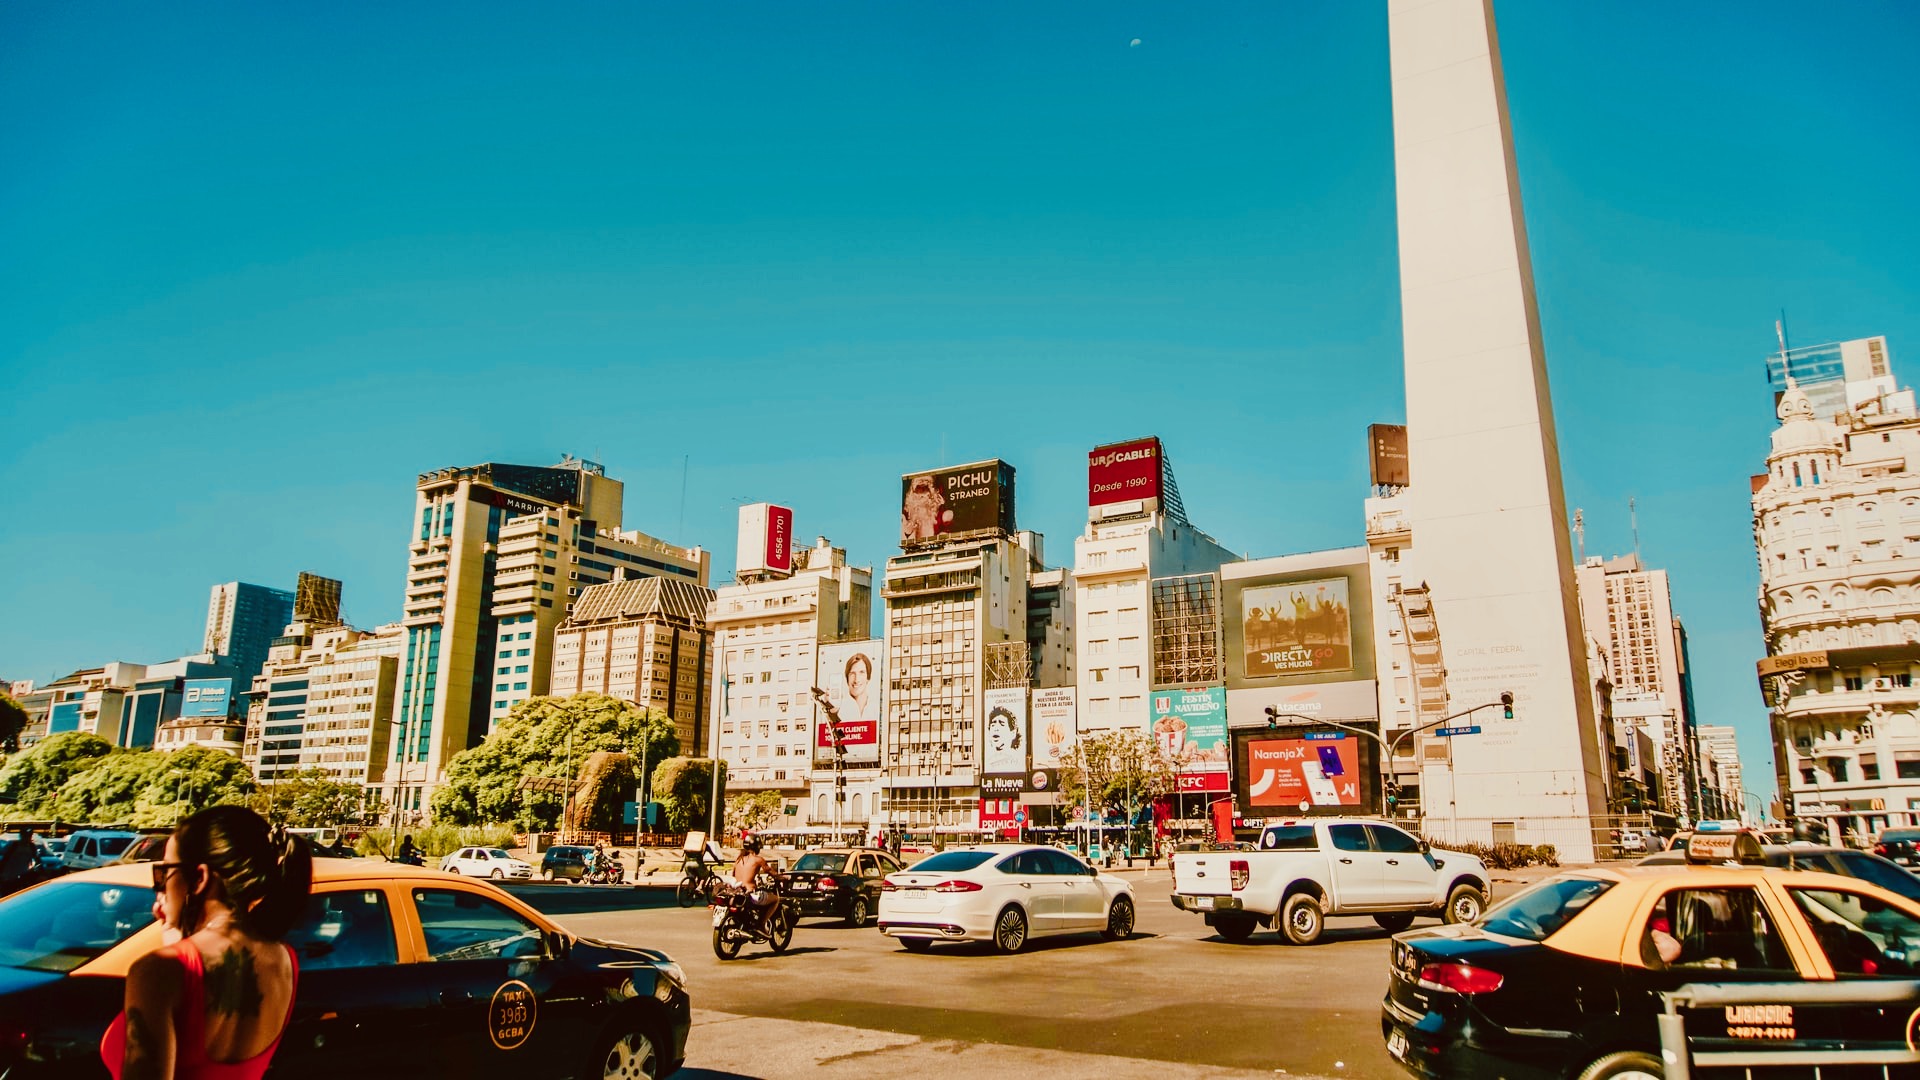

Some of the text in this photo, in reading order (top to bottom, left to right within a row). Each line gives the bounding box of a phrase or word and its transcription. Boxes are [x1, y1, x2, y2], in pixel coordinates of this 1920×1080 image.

[948, 471, 992, 490] PICHU
[1093, 476, 1147, 493] Desde 1990
[950, 487, 990, 501] STRANEO
[776, 515, 784, 560] 4556-1701
[1261, 649, 1312, 664] DIRECTV
[1314, 647, 1334, 659] GO
[1274, 661, 1288, 669] VES
[1288, 660, 1313, 669] MUCHO
[1174, 701, 1220, 713] NAVIDEÑO
[1276, 702, 1322, 712] Atacama
[1254, 747, 1305, 760] Naranja X
[981, 778, 1024, 788] La Nueve
[1177, 777, 1205, 788] KFC
[503, 991, 526, 1003] TAXI
[500, 1006, 527, 1025] 3983
[498, 1026, 524, 1039] GCBA
